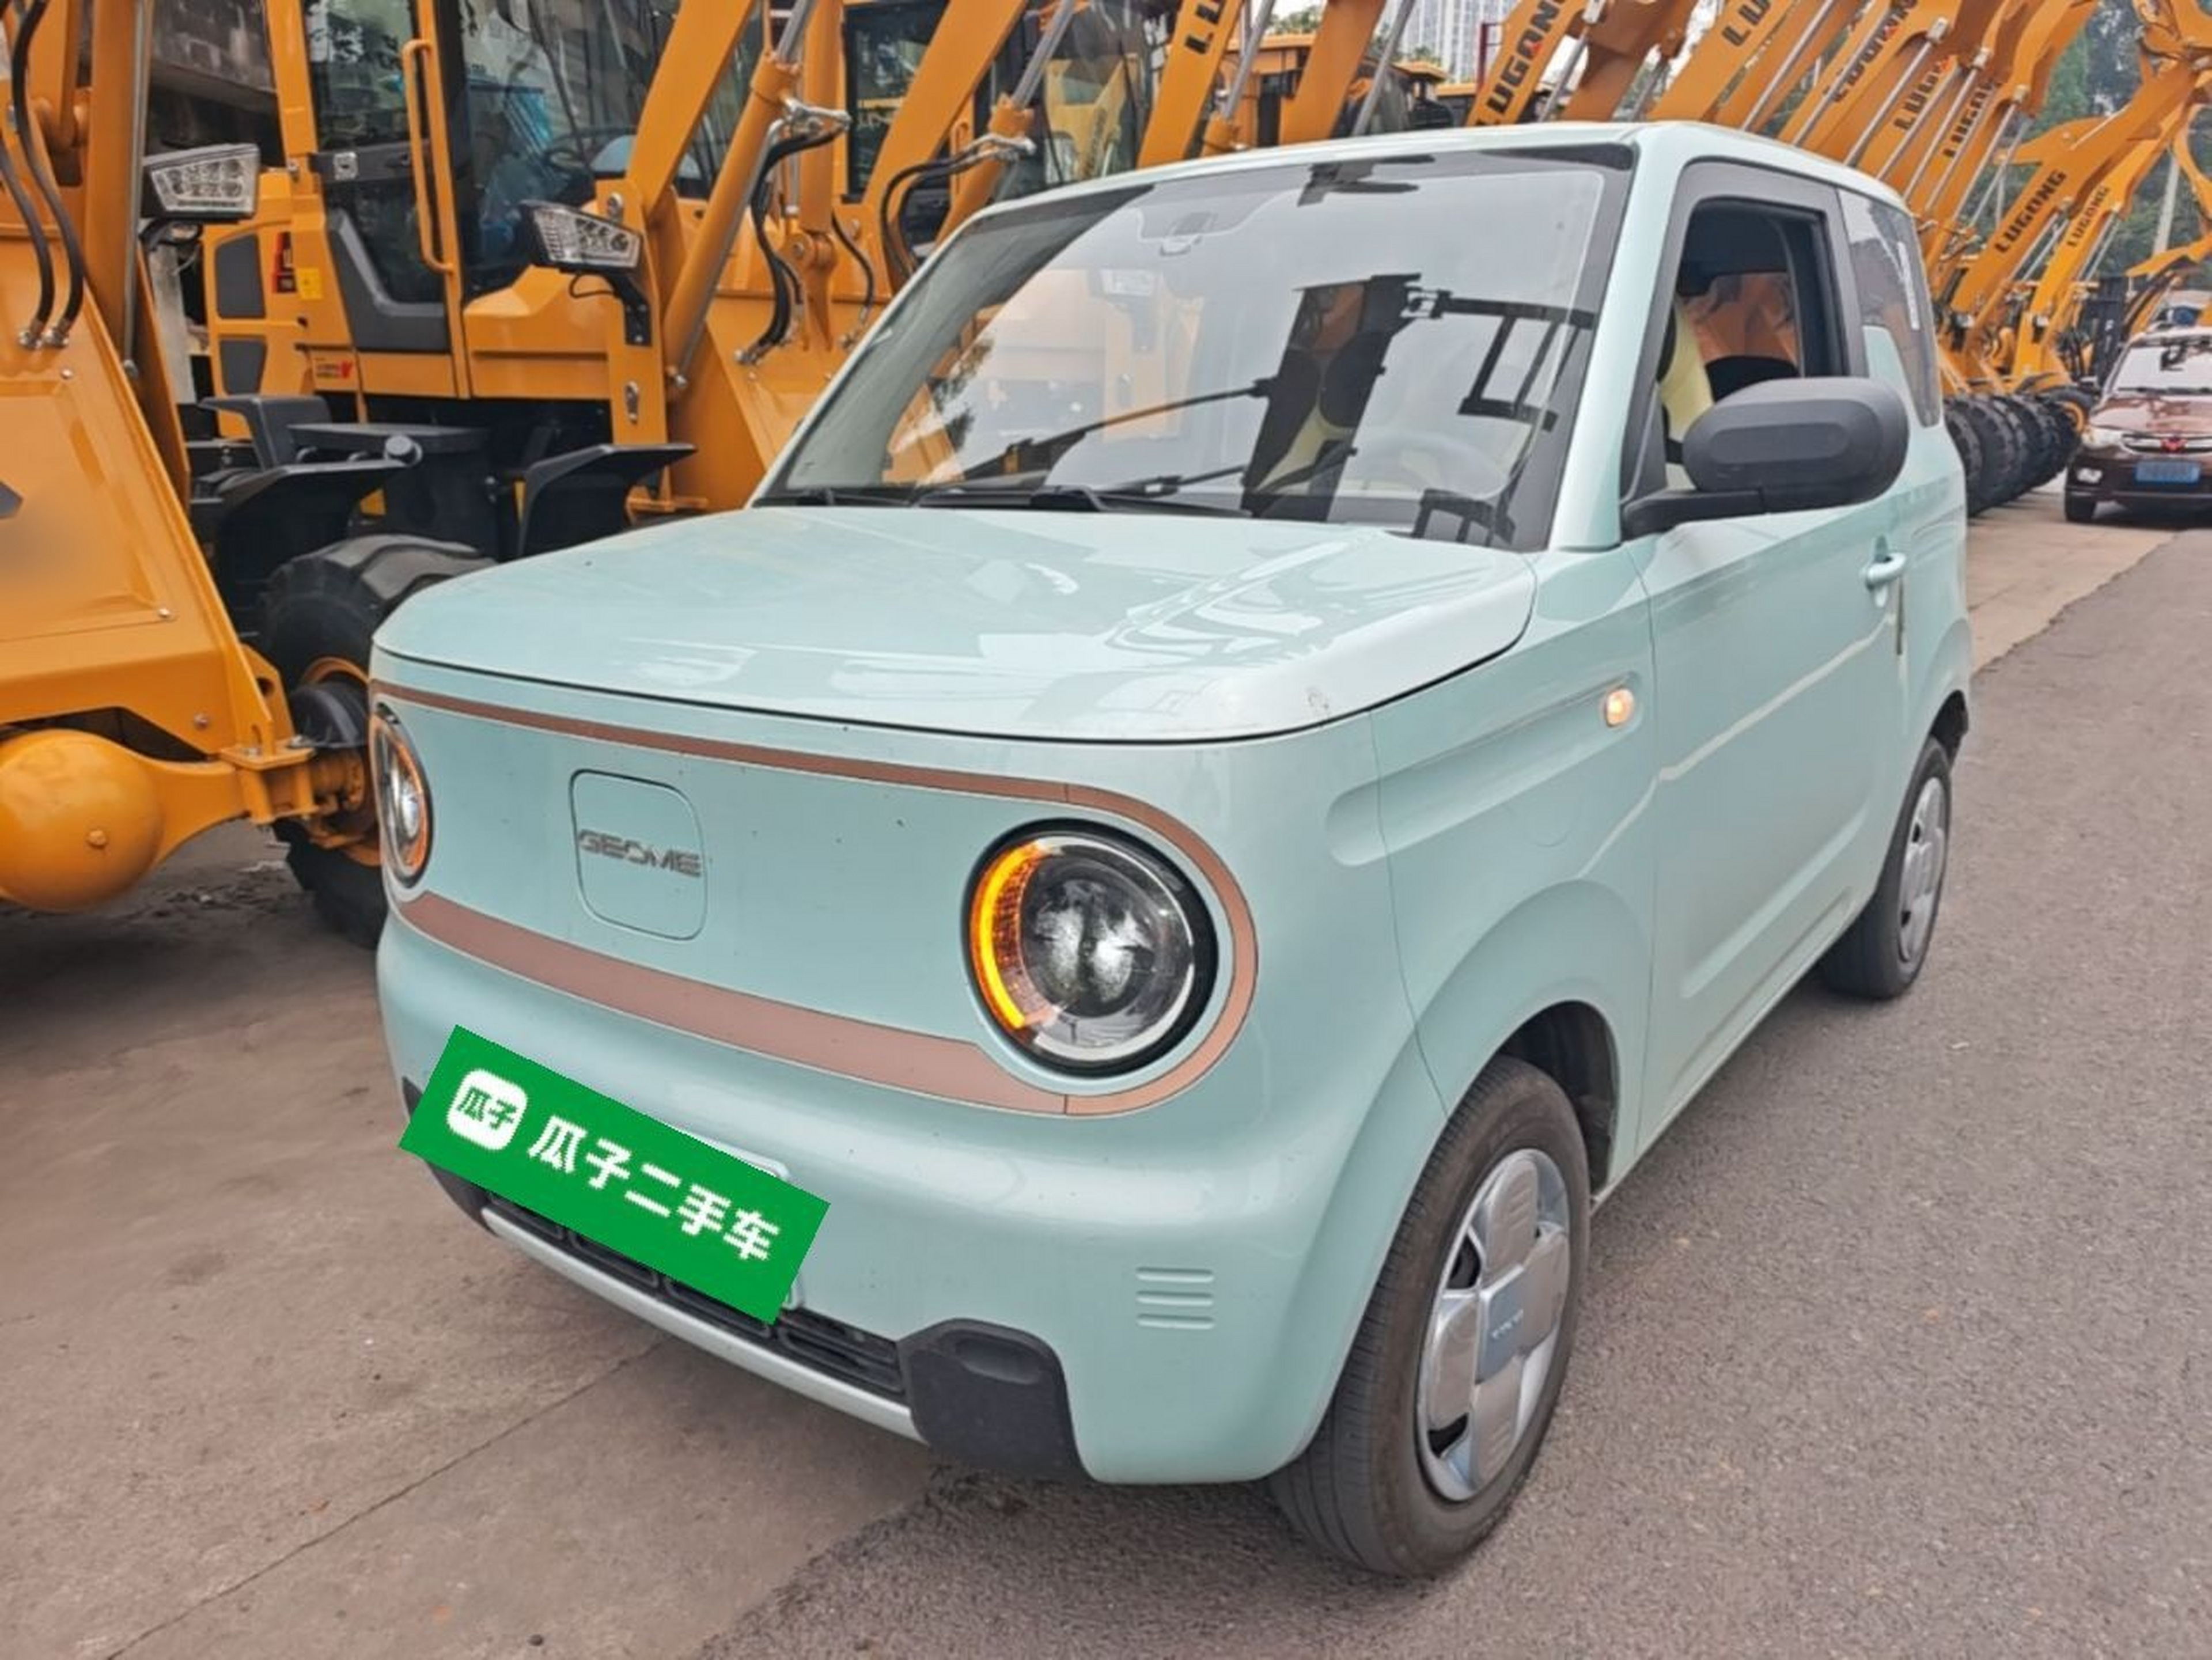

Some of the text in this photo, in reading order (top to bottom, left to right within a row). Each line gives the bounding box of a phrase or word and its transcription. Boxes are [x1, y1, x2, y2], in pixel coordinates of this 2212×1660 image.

[1475, 0, 1565, 125] UGON
[1995, 169, 2066, 253] LUGONG
[578, 828, 701, 878] GEOME
